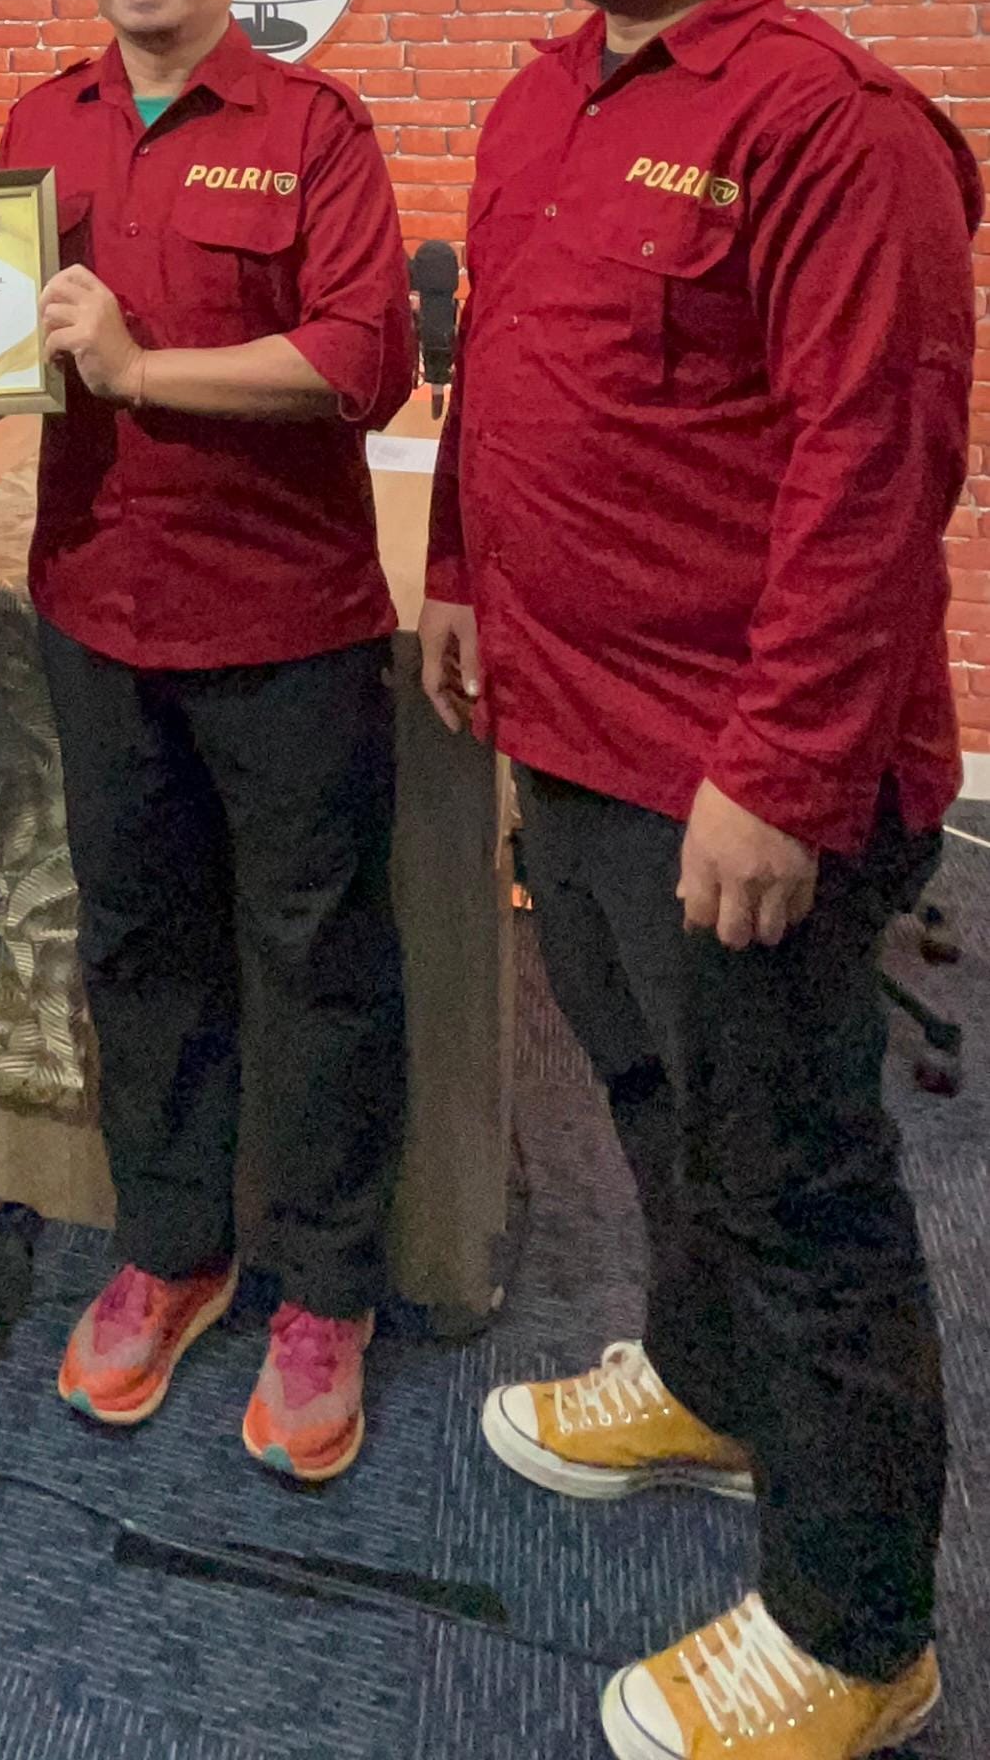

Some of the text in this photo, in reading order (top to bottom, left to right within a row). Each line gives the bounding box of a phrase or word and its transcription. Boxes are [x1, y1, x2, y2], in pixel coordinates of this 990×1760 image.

[184, 164, 273, 191] POLRI
[625, 157, 710, 197] POLRI
[713, 184, 735, 200] TV
